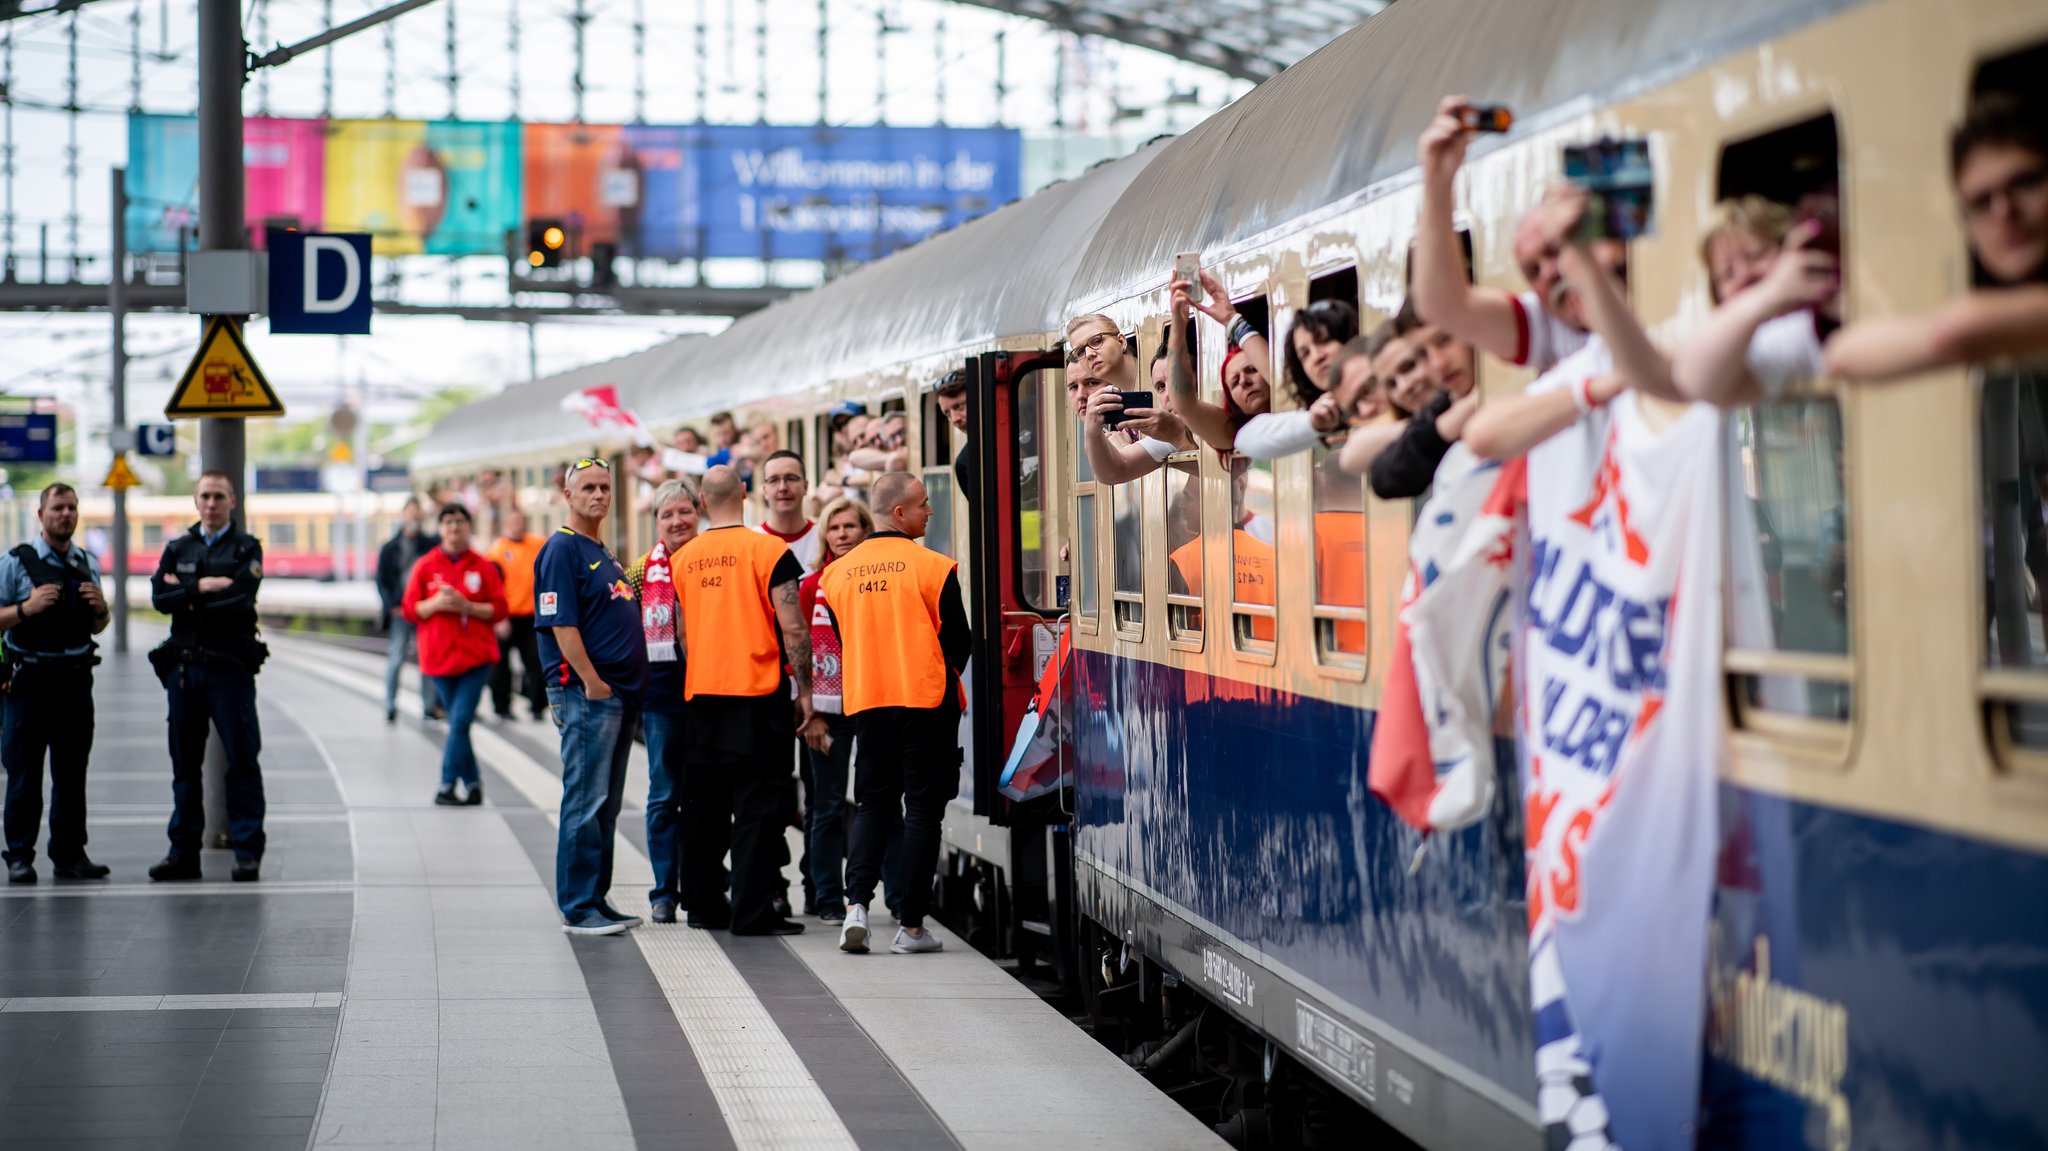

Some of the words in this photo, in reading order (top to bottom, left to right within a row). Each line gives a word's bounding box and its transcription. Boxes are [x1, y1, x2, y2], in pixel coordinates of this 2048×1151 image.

[731, 147, 911, 190] Willkommen
[913, 153, 942, 189] in
[944, 148, 995, 191] der
[303, 236, 362, 314] D
[147, 426, 172, 453] C
[687, 555, 737, 574] STEWARD
[846, 561, 906, 581] STEWARD
[859, 580, 887, 594] 0412
